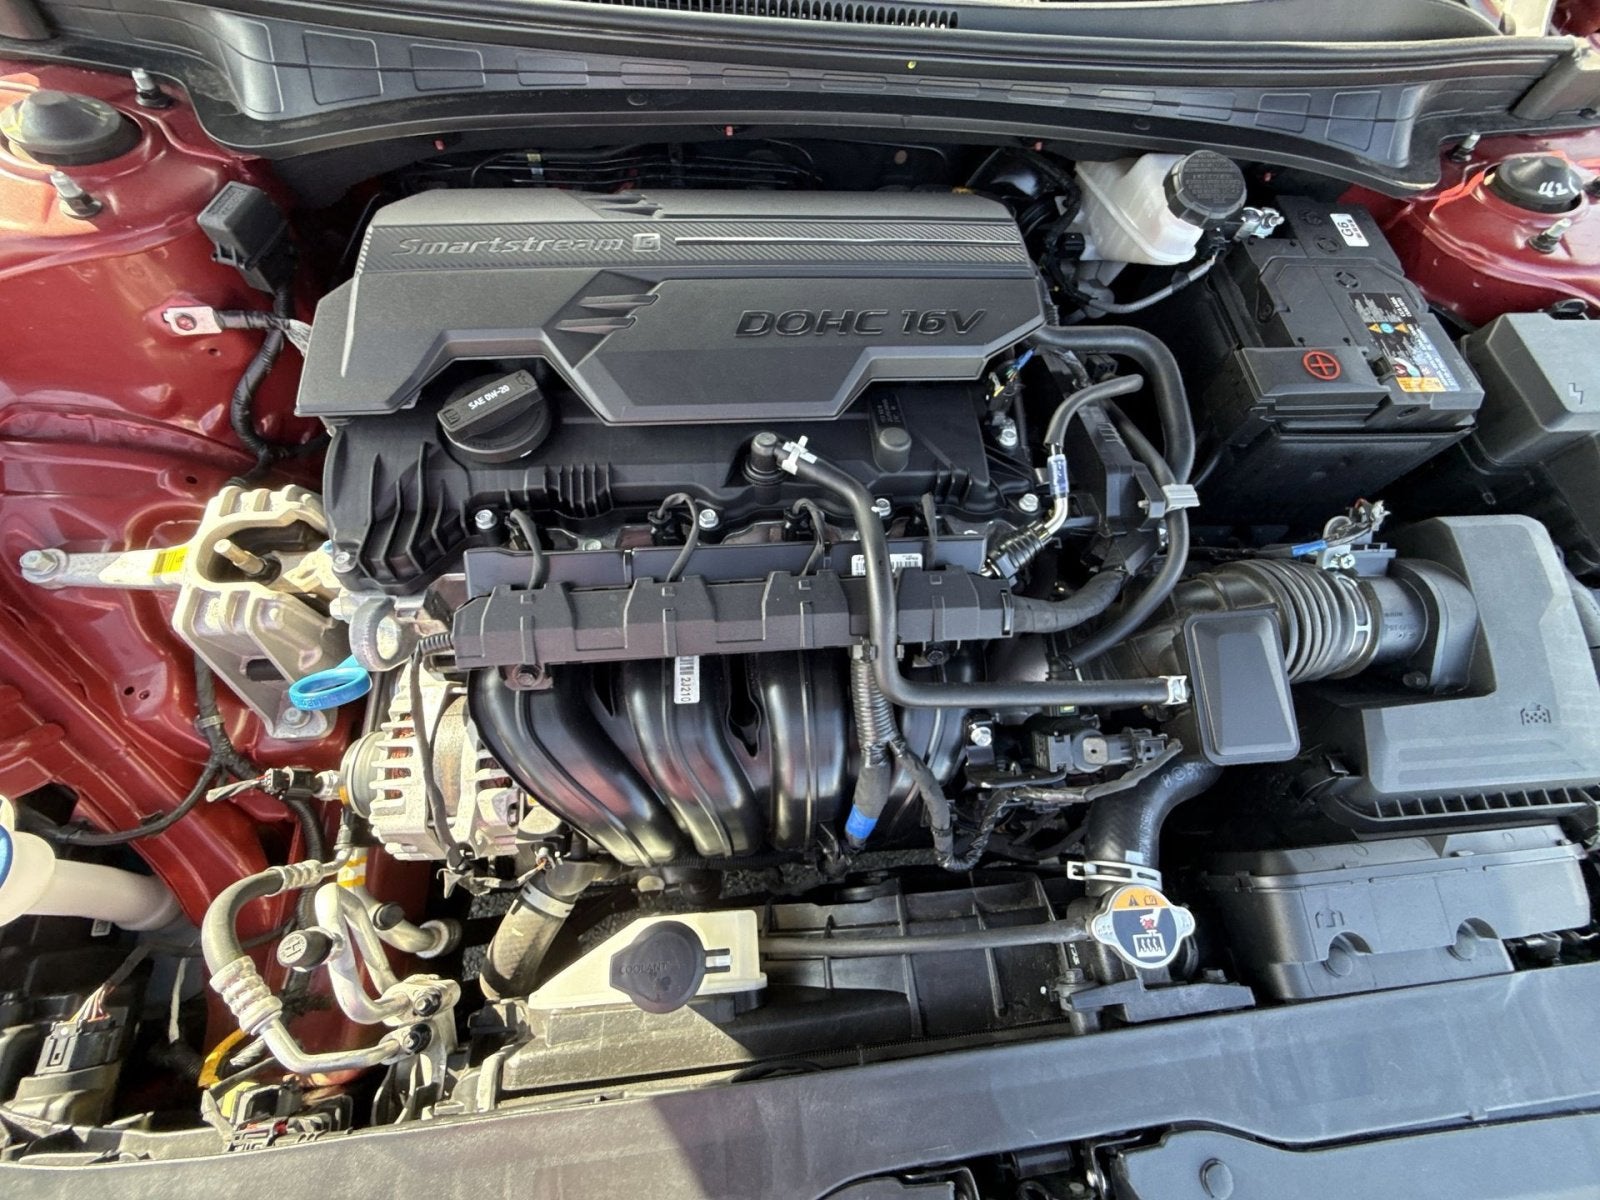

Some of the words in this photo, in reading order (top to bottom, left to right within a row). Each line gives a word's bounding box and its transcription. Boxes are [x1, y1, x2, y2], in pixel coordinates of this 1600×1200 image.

[392, 236, 624, 256] Smartstream
[734, 309, 889, 337] DOHC
[901, 309, 987, 336] 16V
[468, 397, 486, 410] SAE
[484, 384, 510, 402] 0W-20
